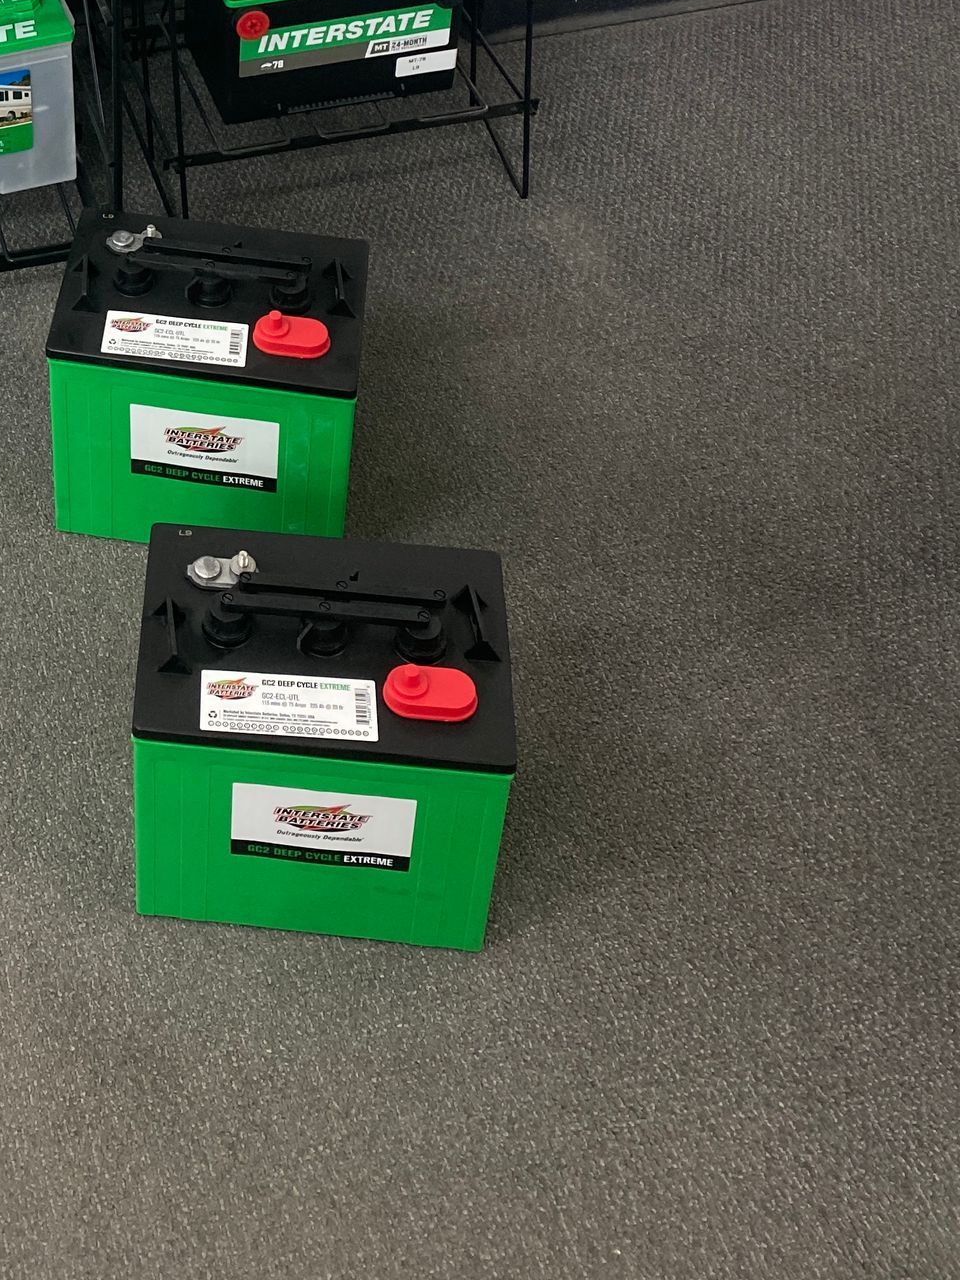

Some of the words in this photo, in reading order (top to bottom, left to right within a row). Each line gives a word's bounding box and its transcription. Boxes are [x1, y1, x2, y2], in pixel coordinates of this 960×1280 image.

[257, 9, 434, 53] INTERSTATE
[272, 59, 284, 70] 78
[374, 43, 388, 52] MT
[392, 36, 427, 47] 24-MONTH
[167, 429, 241, 444] INTERSTATE
[168, 436, 235, 450] BATTERIES
[167, 450, 203, 460] Outrageously
[205, 455, 237, 463] Dependable
[145, 464, 163, 474] GC2
[166, 467, 189, 477] DEEP
[191, 472, 220, 482] CYCLE
[223, 475, 264, 488] EXTREME
[208, 683, 256, 692] INTERSTATE
[277, 680, 296, 688] DEEP
[296, 681, 319, 689] CYCLE
[320, 682, 351, 691] EXTREME
[209, 689, 253, 697] BATTERIES
[262, 692, 299, 701] GC2-ECL-UTL
[276, 807, 368, 822] INTERSTATE
[278, 815, 361, 829] BATTERIES
[276, 829, 320, 840] Outrageously
[248, 844, 270, 854] GC2
[274, 848, 302, 857] DEEP
[306, 852, 340, 862] CYCLE
[344, 855, 393, 866] EXTREME
